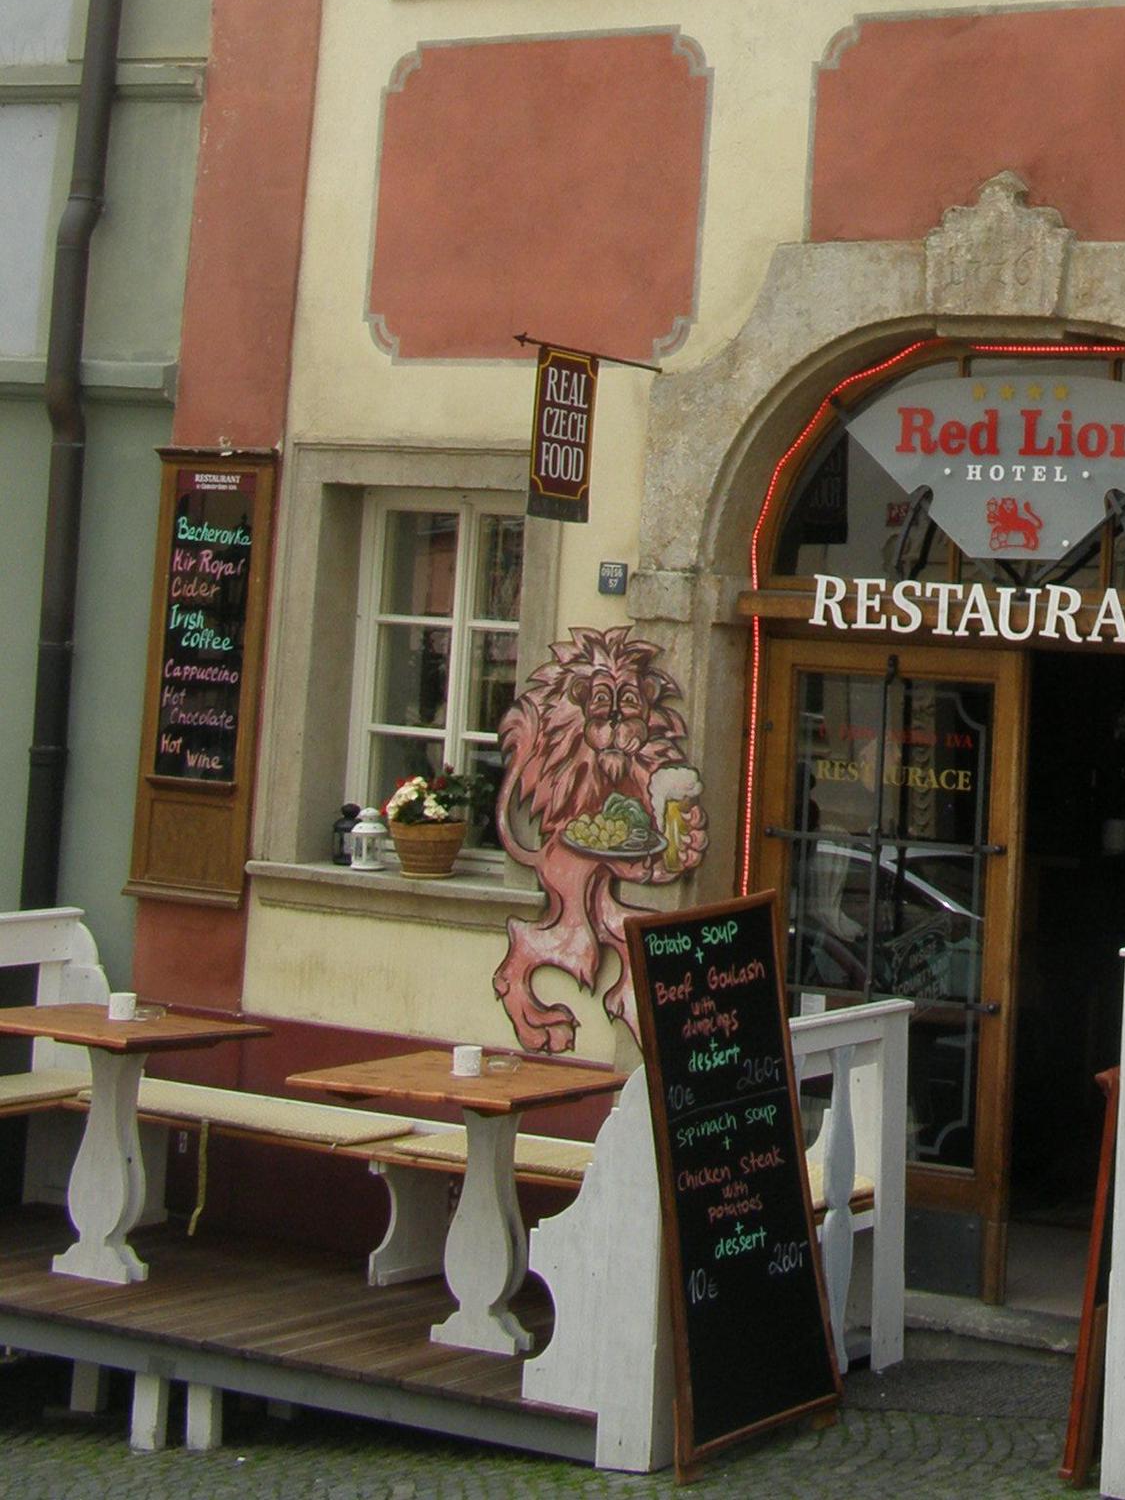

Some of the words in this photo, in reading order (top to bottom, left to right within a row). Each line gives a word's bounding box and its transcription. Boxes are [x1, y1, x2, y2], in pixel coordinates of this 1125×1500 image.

[545, 366, 588, 408] REAL
[542, 407, 587, 444] CZECH
[896, 406, 999, 457] Red
[540, 442, 584, 482] FOOD
[966, 464, 1067, 483] HOTEL
[195, 473, 241, 484] RESTAURANT
[177, 516, 252, 546] Becherovka
[172, 548, 196, 572] Kir
[199, 549, 245, 581] Royal
[171, 577, 221, 598] Cider
[169, 603, 205, 631] Irish
[181, 628, 234, 651] coffee
[164, 658, 240, 685] Cappuccino
[161, 685, 186, 707] Hot
[160, 733, 183, 754] Hot
[645, 932, 692, 956] Potato
[655, 971, 692, 1005] Beef
[688, 1044, 740, 1075] dessert
[715, 1226, 767, 1259] dessert
